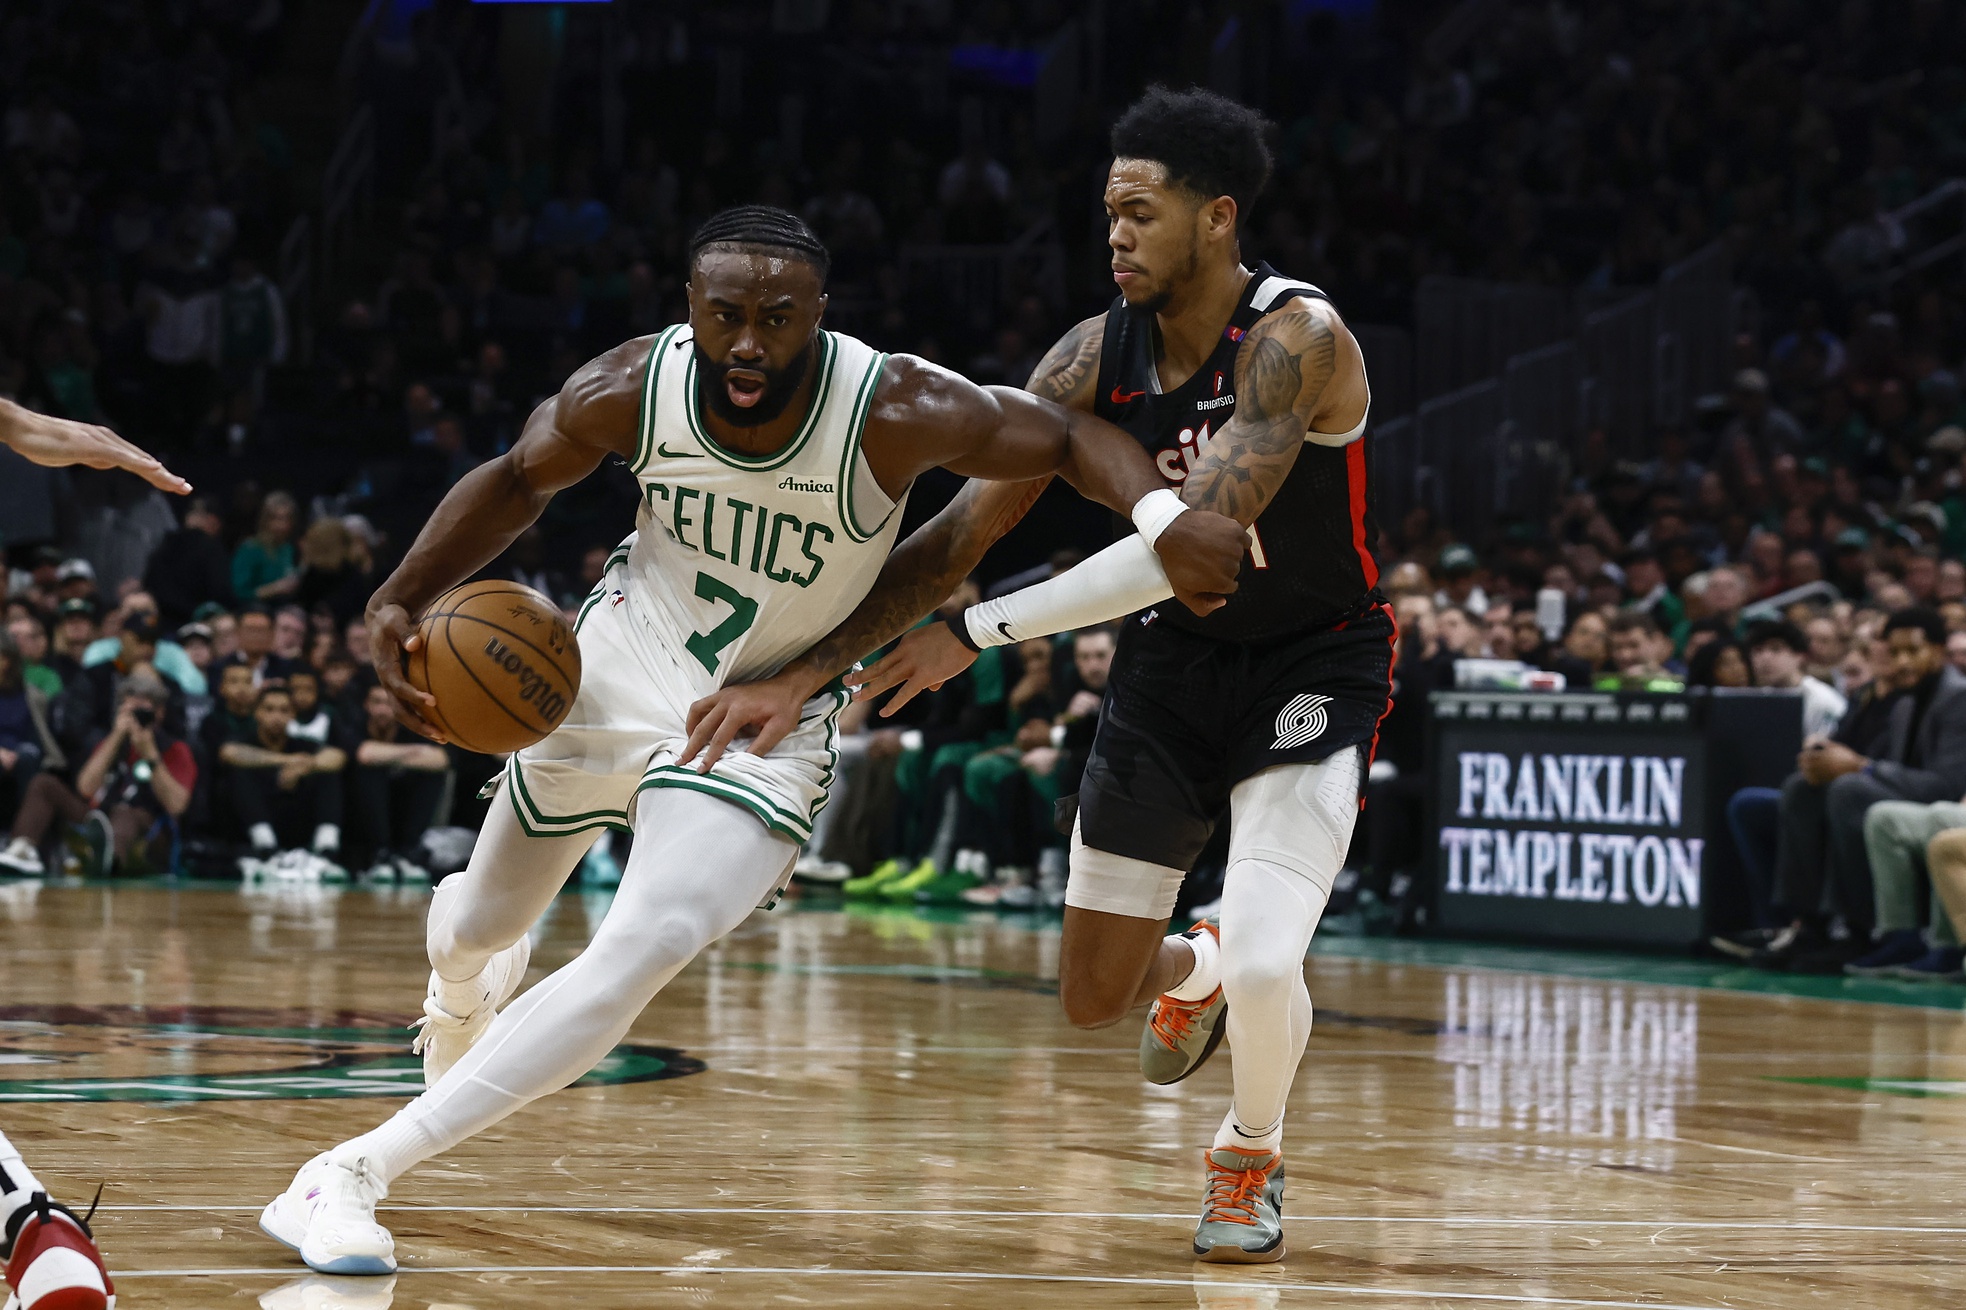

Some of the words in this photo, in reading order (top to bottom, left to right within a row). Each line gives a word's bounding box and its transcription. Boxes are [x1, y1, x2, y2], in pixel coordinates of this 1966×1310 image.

[778, 476, 835, 493] Amica
[646, 482, 835, 588] CELTICS
[684, 570, 759, 677] 7
[484, 635, 567, 726] Wilson
[1457, 752, 1686, 828] FRANKLIN
[1439, 826, 1705, 909] TEMPLETON
